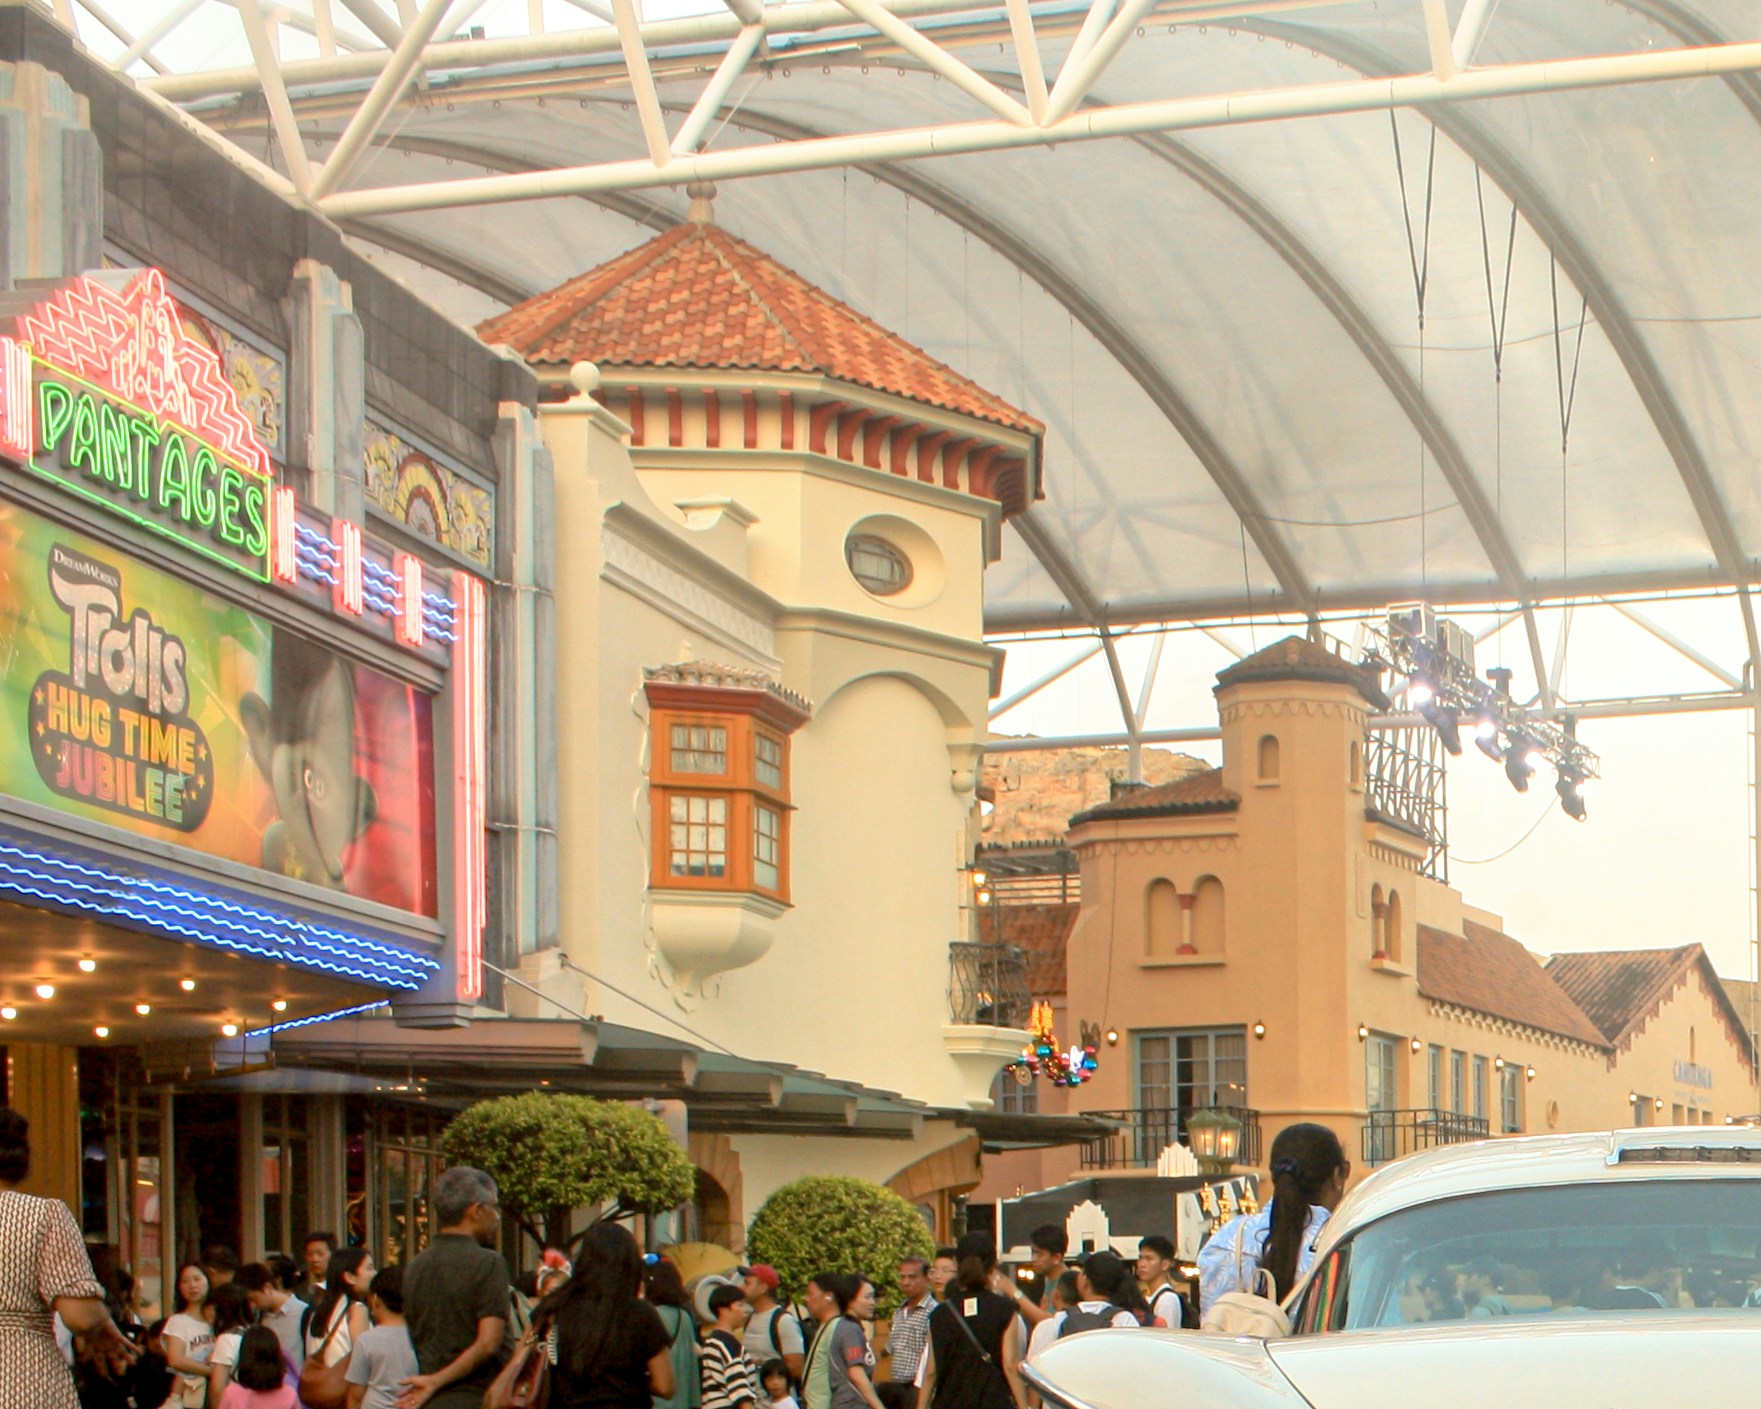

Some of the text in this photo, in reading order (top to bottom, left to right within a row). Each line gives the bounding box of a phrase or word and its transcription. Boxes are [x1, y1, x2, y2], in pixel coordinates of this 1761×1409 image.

[39, 382, 268, 556] PANTAGES
[51, 567, 187, 715] Trolls
[48, 681, 196, 776] HUG TIME
[56, 739, 184, 823] JUBILEE
